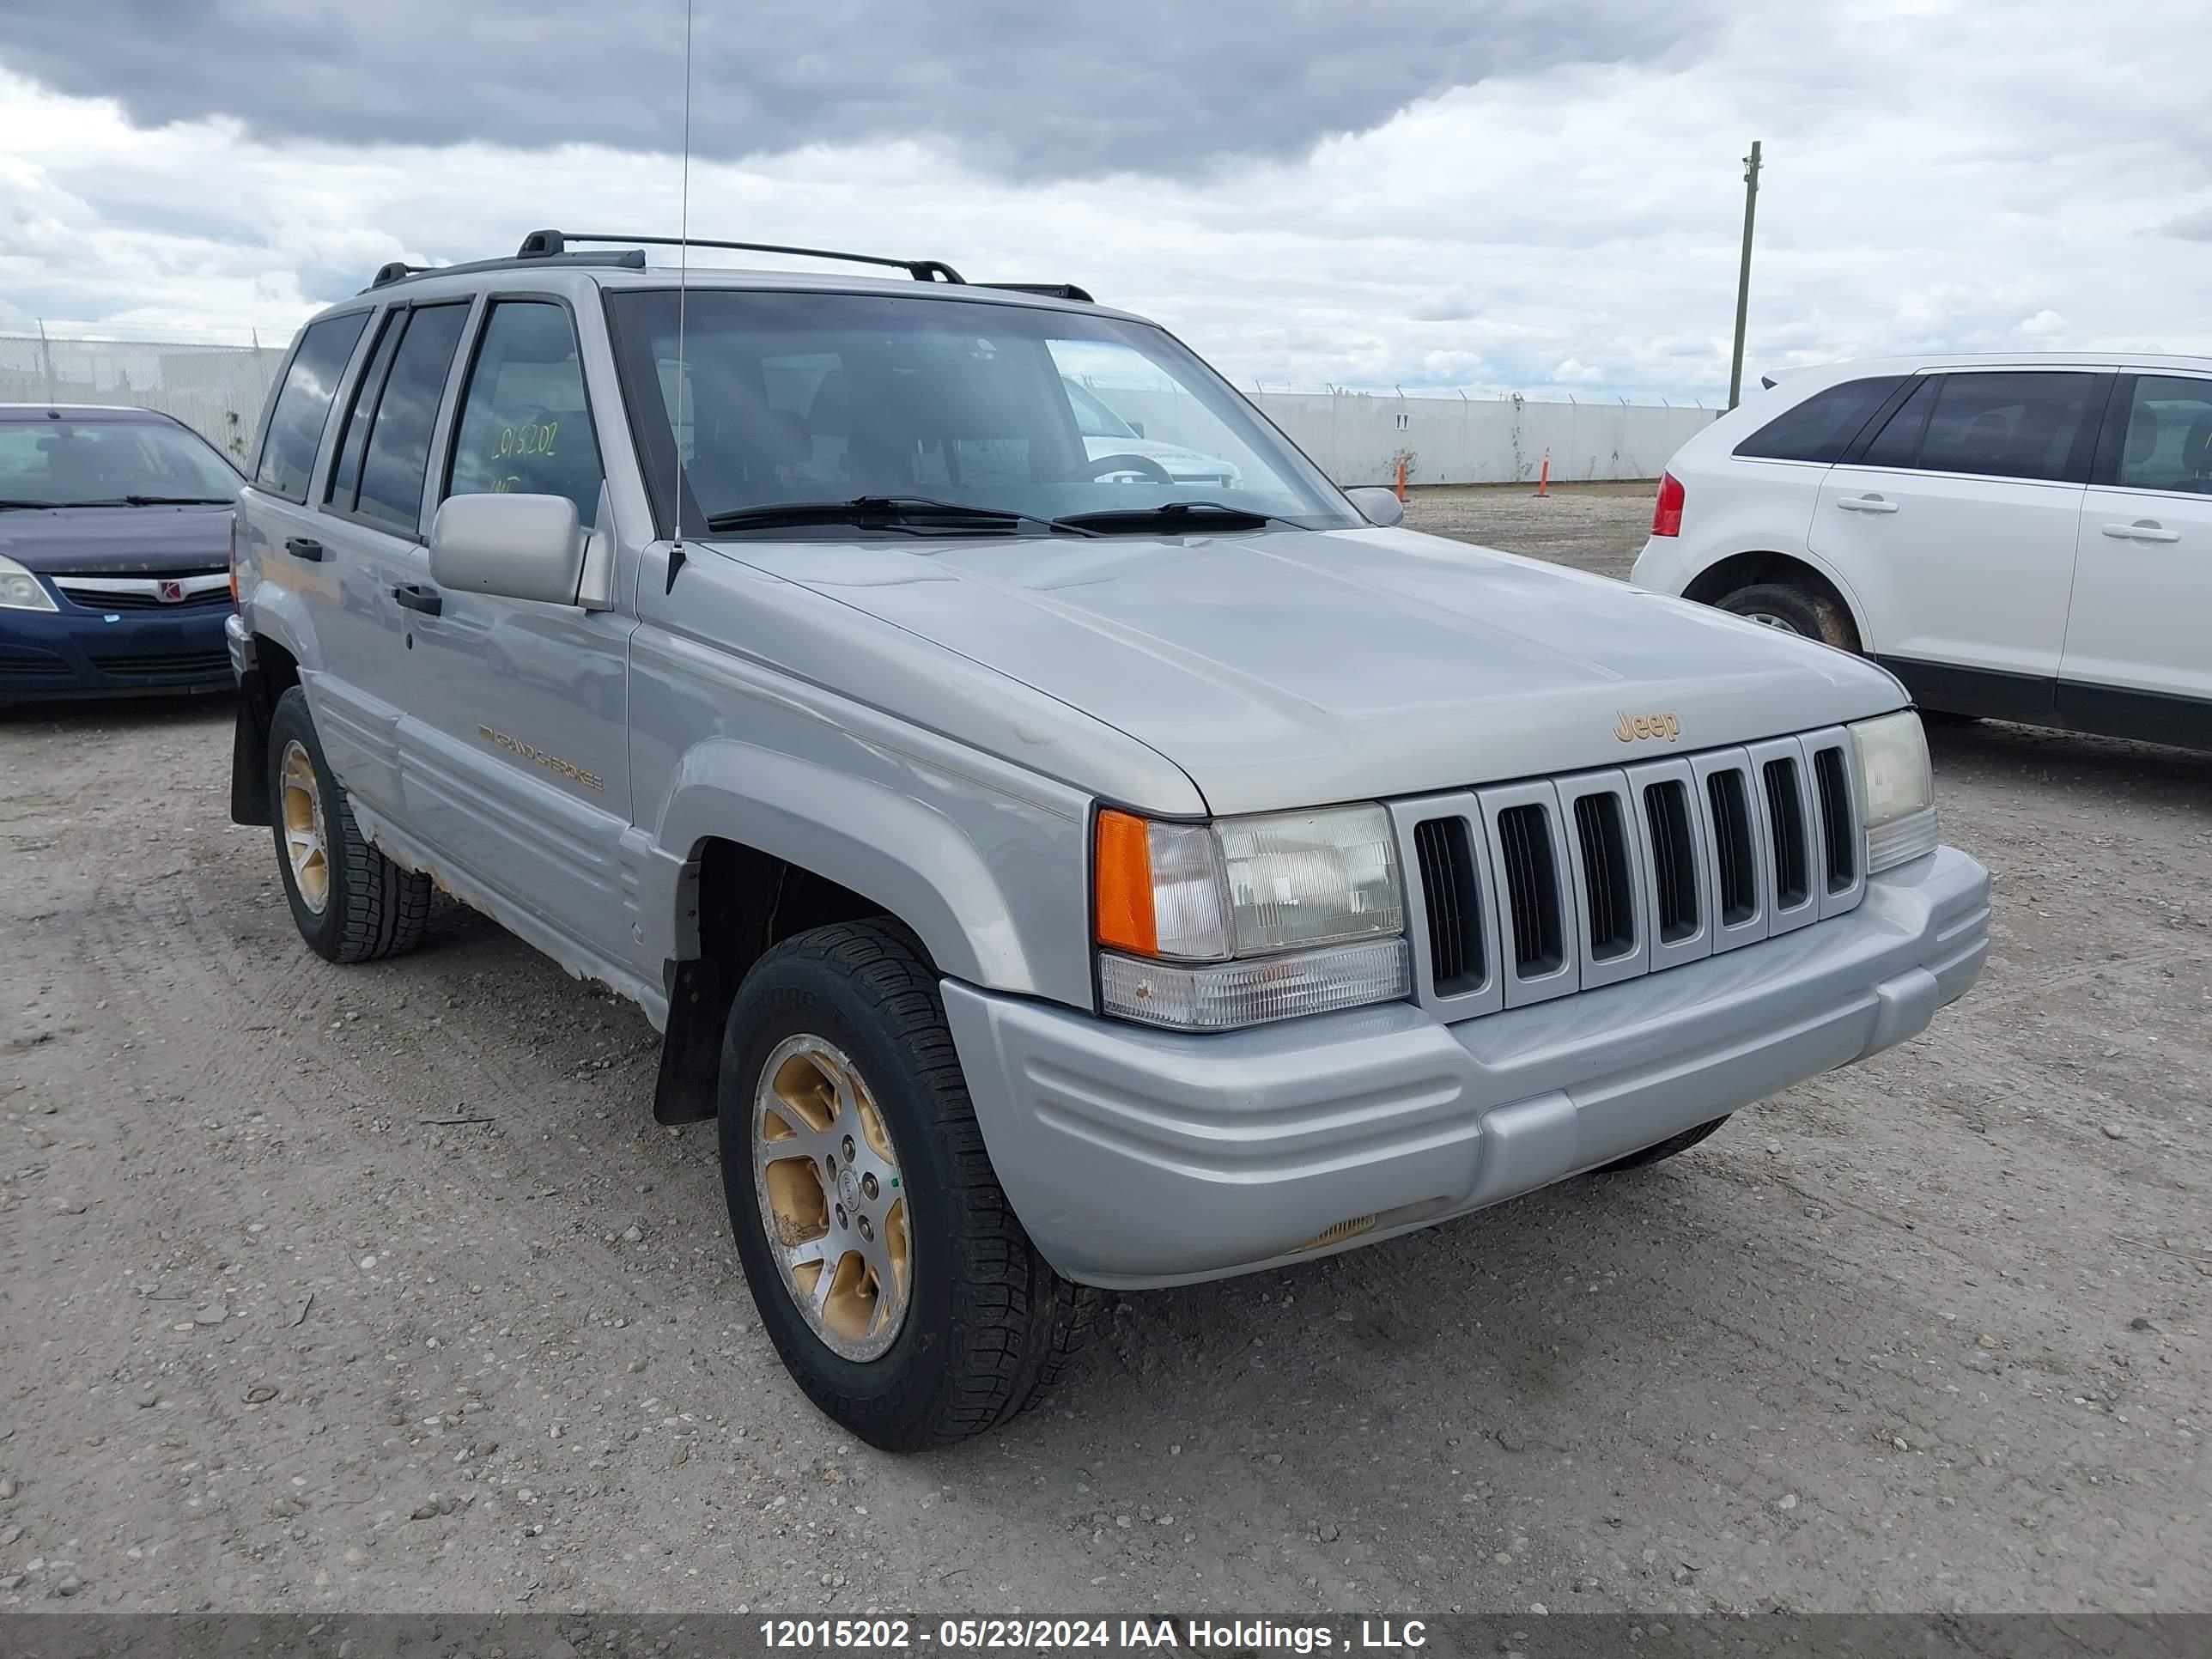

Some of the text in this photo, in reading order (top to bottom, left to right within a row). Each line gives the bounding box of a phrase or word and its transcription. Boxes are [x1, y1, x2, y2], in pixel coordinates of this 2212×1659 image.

[1613, 709, 1681, 743] Jeep
[496, 732, 605, 792] GRAND CHEROKEE
